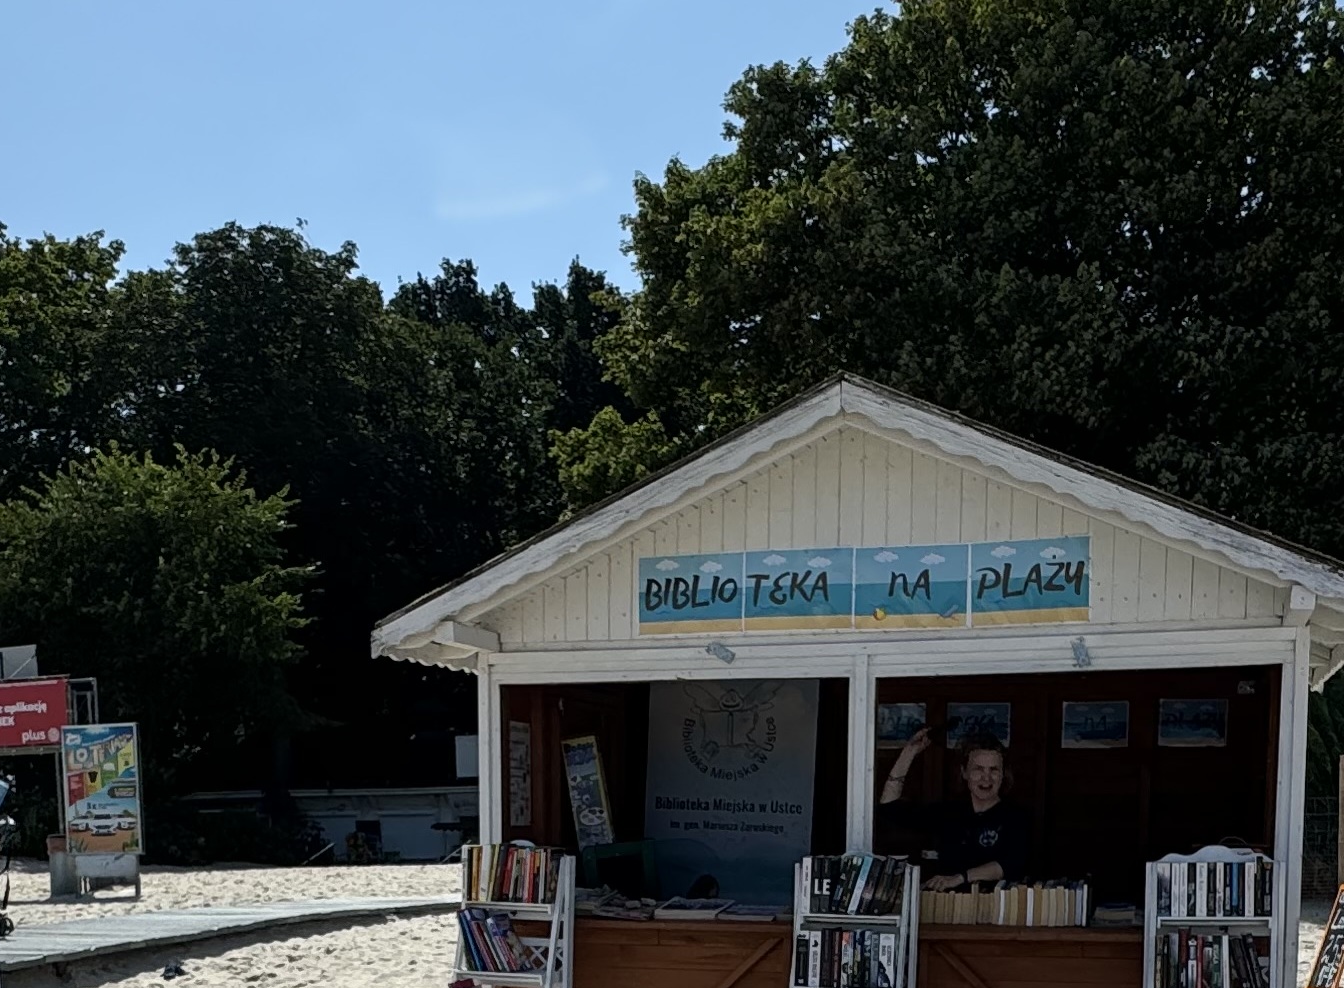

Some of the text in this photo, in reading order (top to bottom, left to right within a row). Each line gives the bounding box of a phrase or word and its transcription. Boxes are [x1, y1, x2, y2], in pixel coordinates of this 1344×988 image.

[975, 554, 1086, 599] PLAŻY
[22, 729, 46, 744] plus
[682, 718, 708, 774] Biblioteka
[710, 763, 760, 781] Miejska
[763, 717, 776, 752] Ustce
[656, 796, 802, 815] Biblioteka Miejska w Ustce
